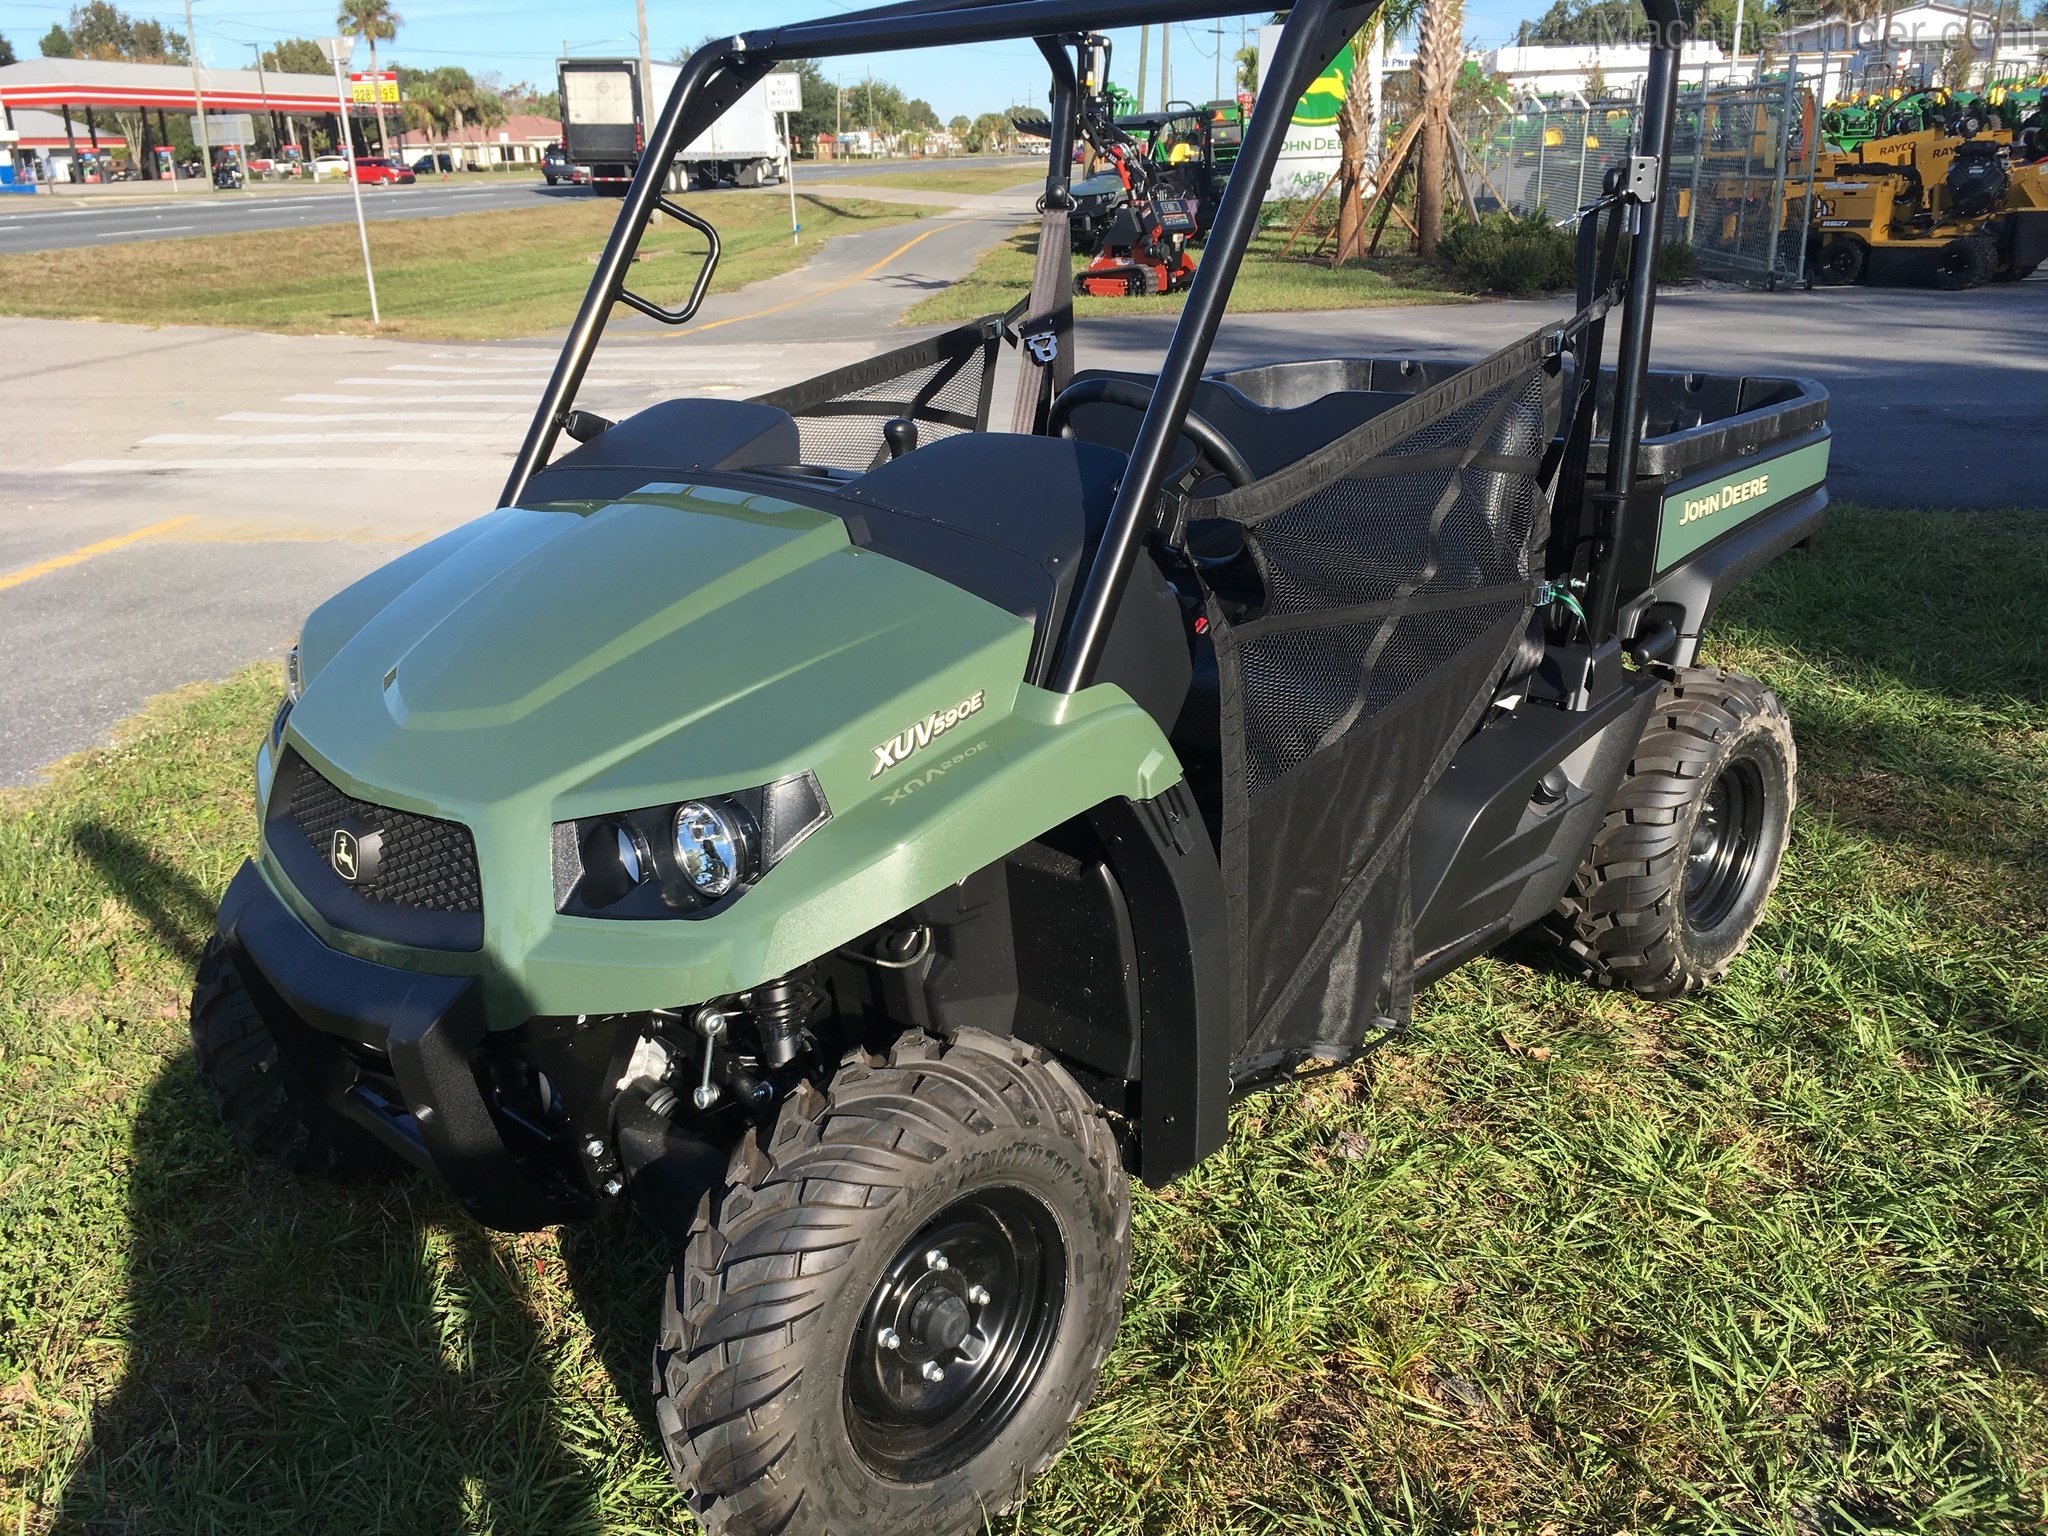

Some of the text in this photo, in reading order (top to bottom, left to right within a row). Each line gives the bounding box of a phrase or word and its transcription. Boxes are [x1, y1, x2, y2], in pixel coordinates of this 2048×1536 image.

[771, 89, 794, 97] MOTOR
[771, 98, 796, 107] VEHICLES
[1281, 137, 1343, 152] OHN DEE
[1880, 141, 1917, 156] RAYCO
[1932, 147, 1954, 159] RAY
[1679, 474, 1769, 526] JOHN DEERE
[870, 689, 985, 780] XUV590E
